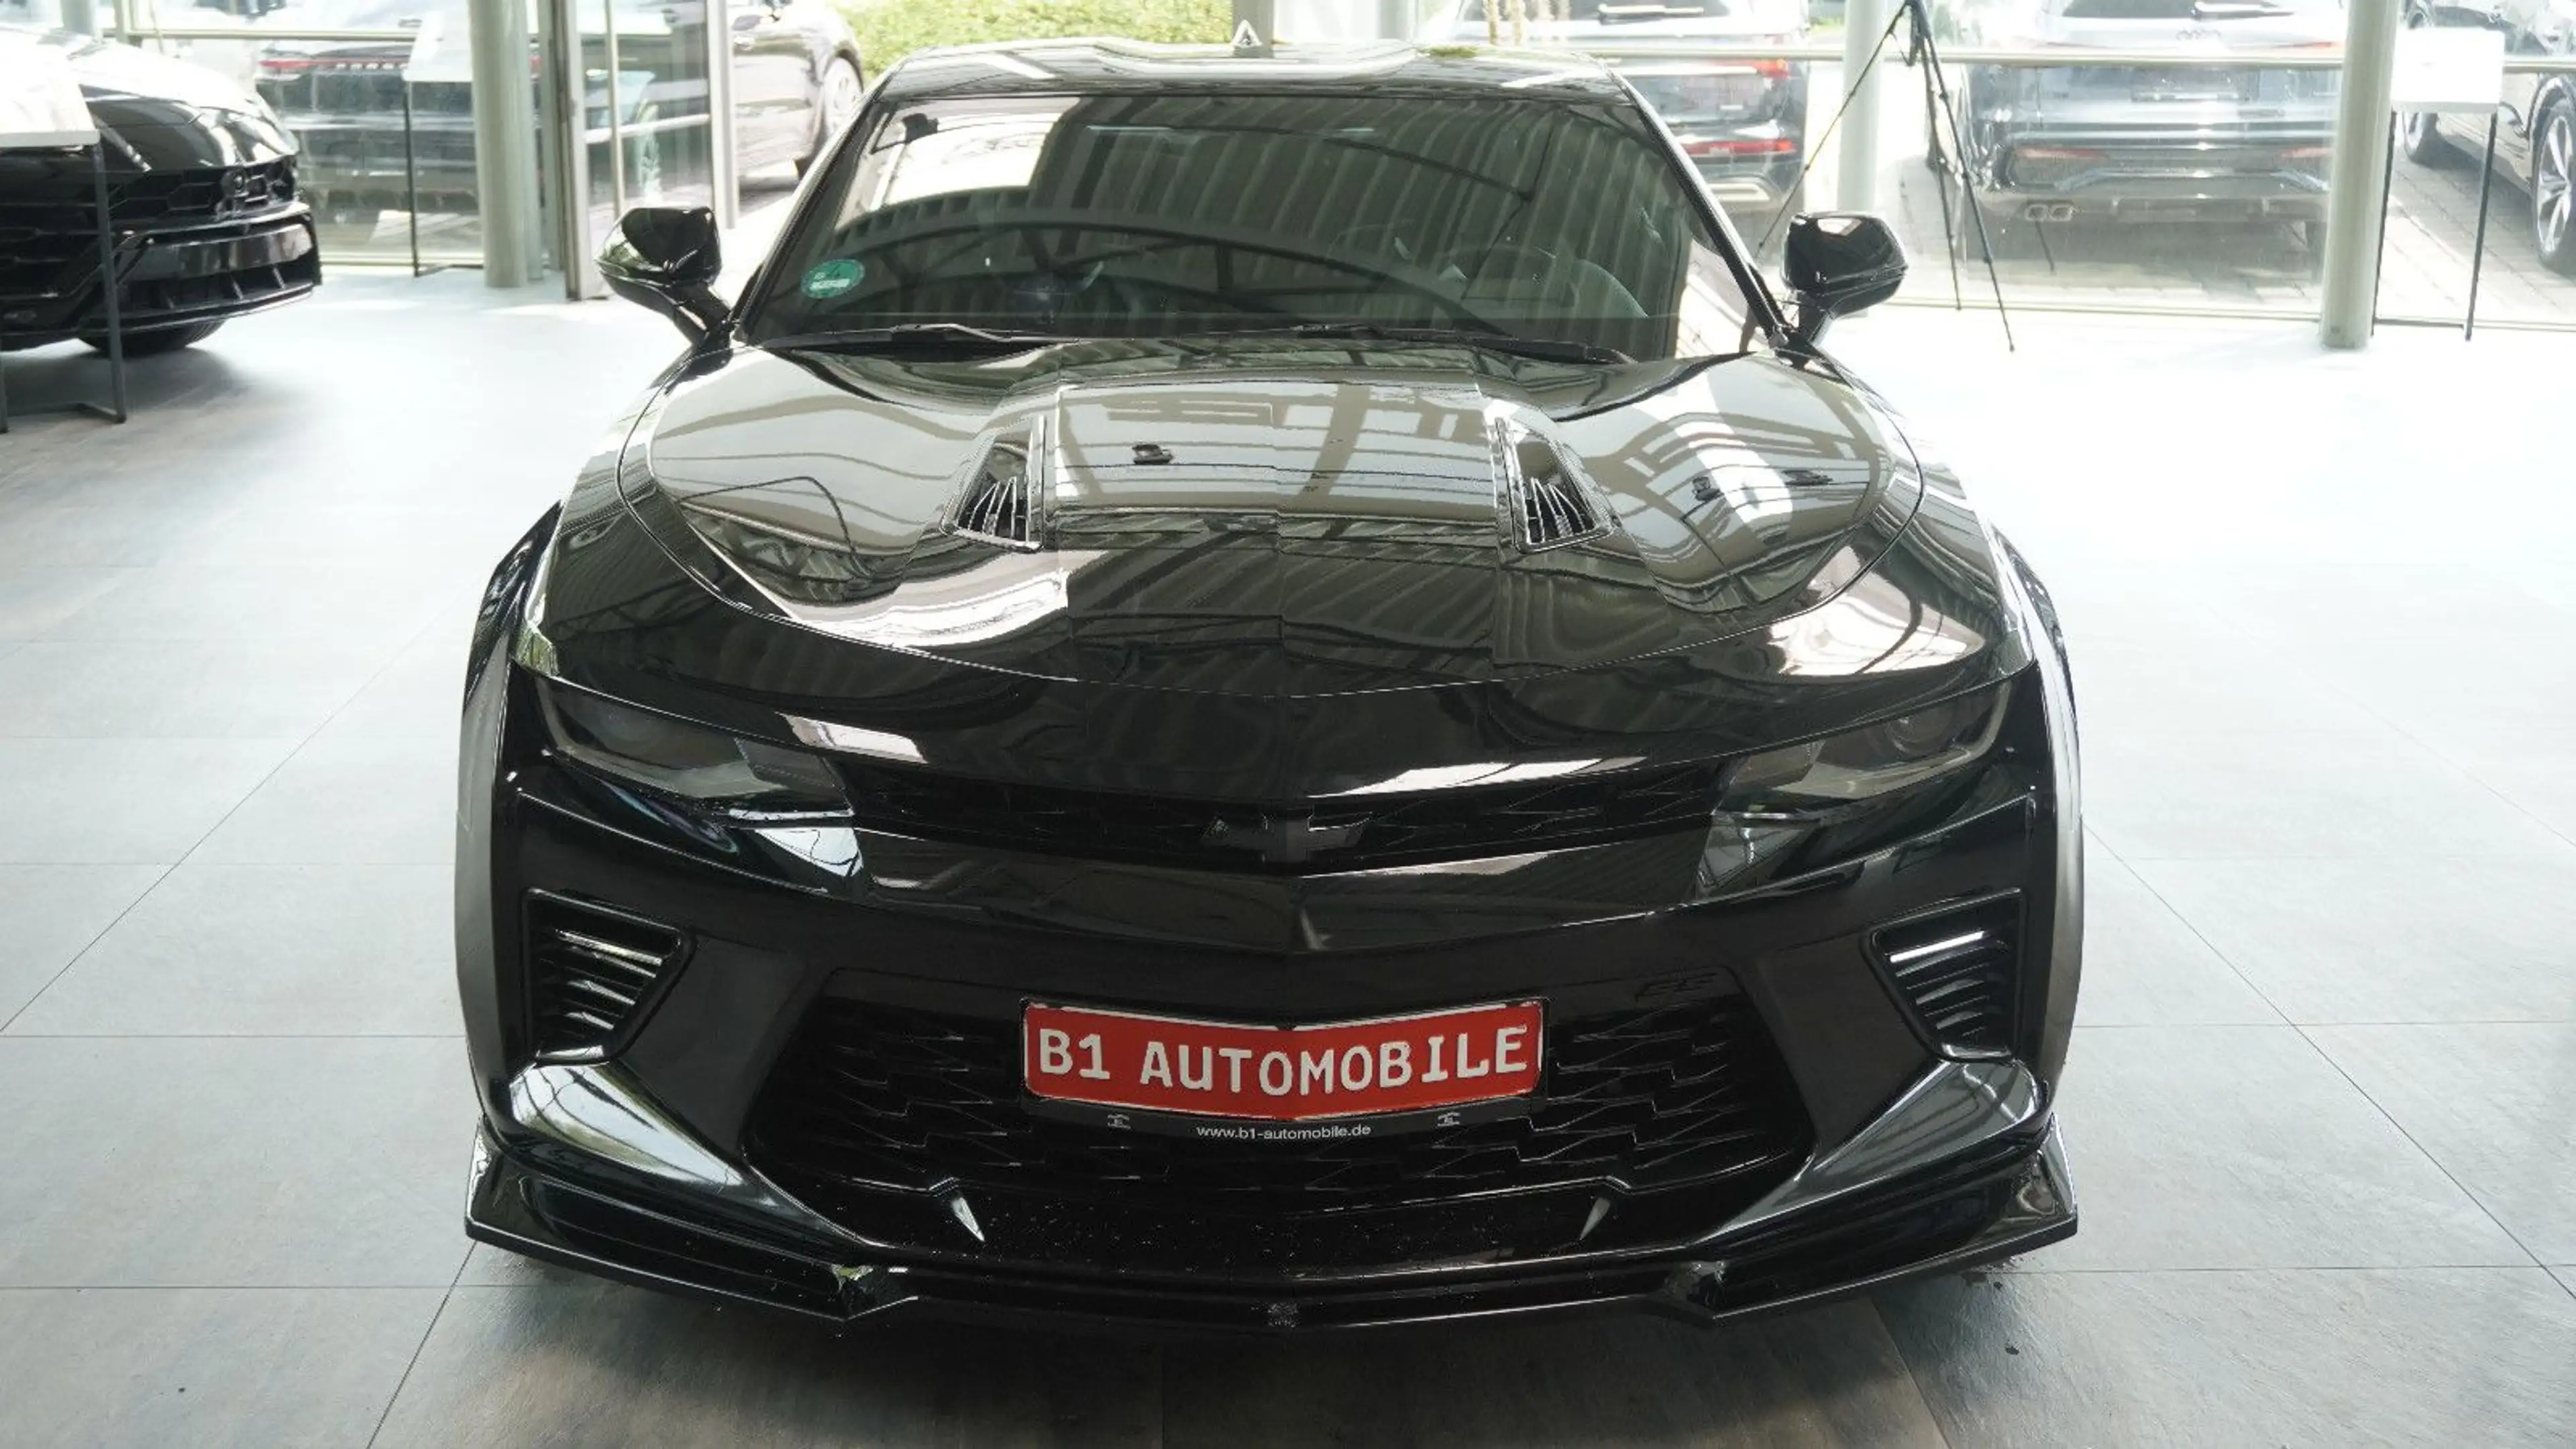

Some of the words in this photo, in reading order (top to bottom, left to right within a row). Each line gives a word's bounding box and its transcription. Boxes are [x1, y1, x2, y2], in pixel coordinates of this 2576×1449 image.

[1039, 1028, 1110, 1079] B1
[1140, 1024, 1527, 1095] AUTOMOBILE
[1196, 1124, 1371, 1140] www.b1-automobile.de
